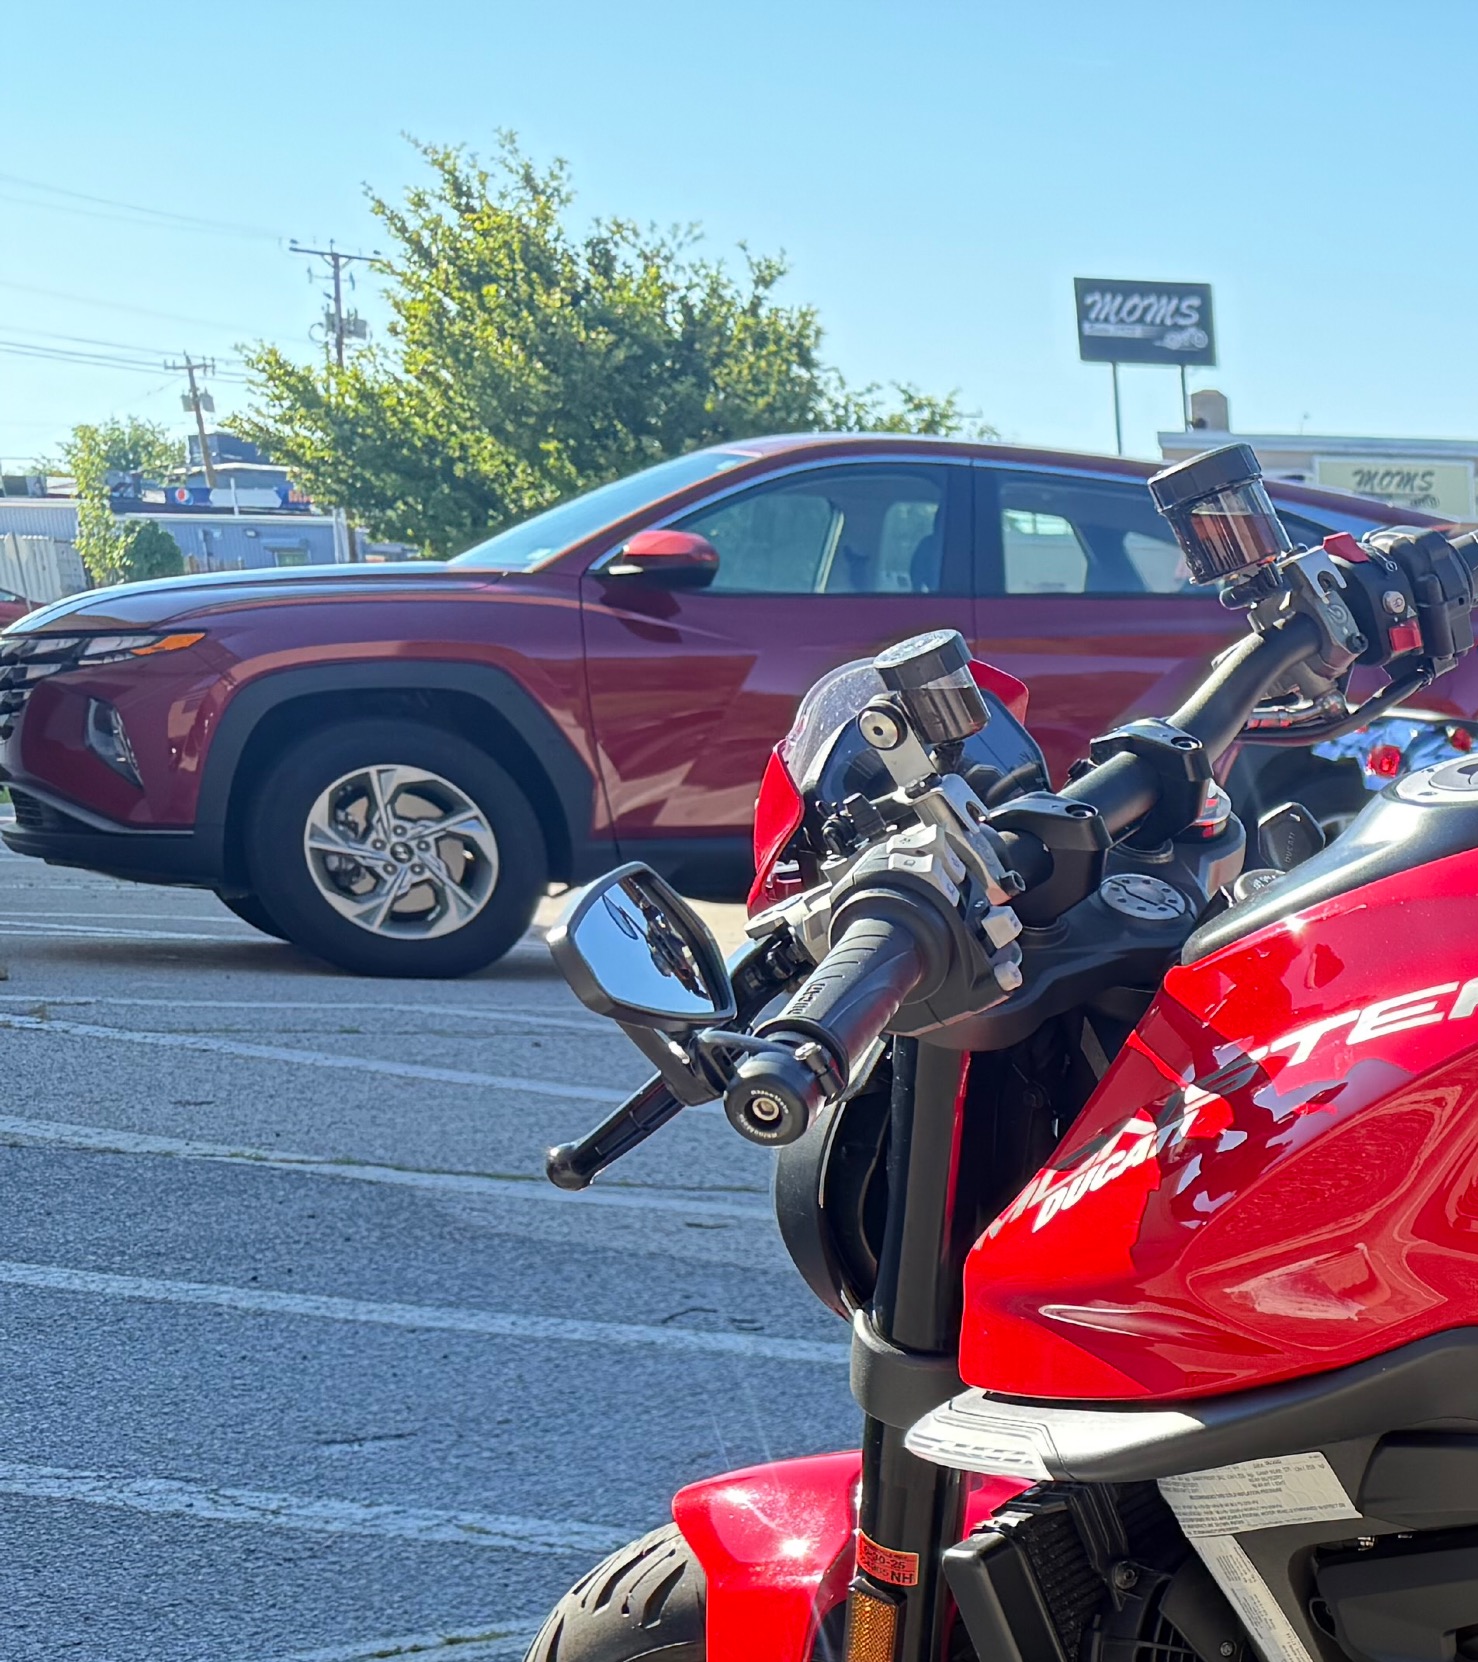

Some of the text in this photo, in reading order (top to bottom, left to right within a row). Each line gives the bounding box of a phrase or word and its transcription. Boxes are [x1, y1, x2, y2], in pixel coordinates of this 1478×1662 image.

[1084, 290, 1201, 326] MOMS
[1353, 469, 1434, 492] MOMS
[890, 1570, 913, 1584] NH
